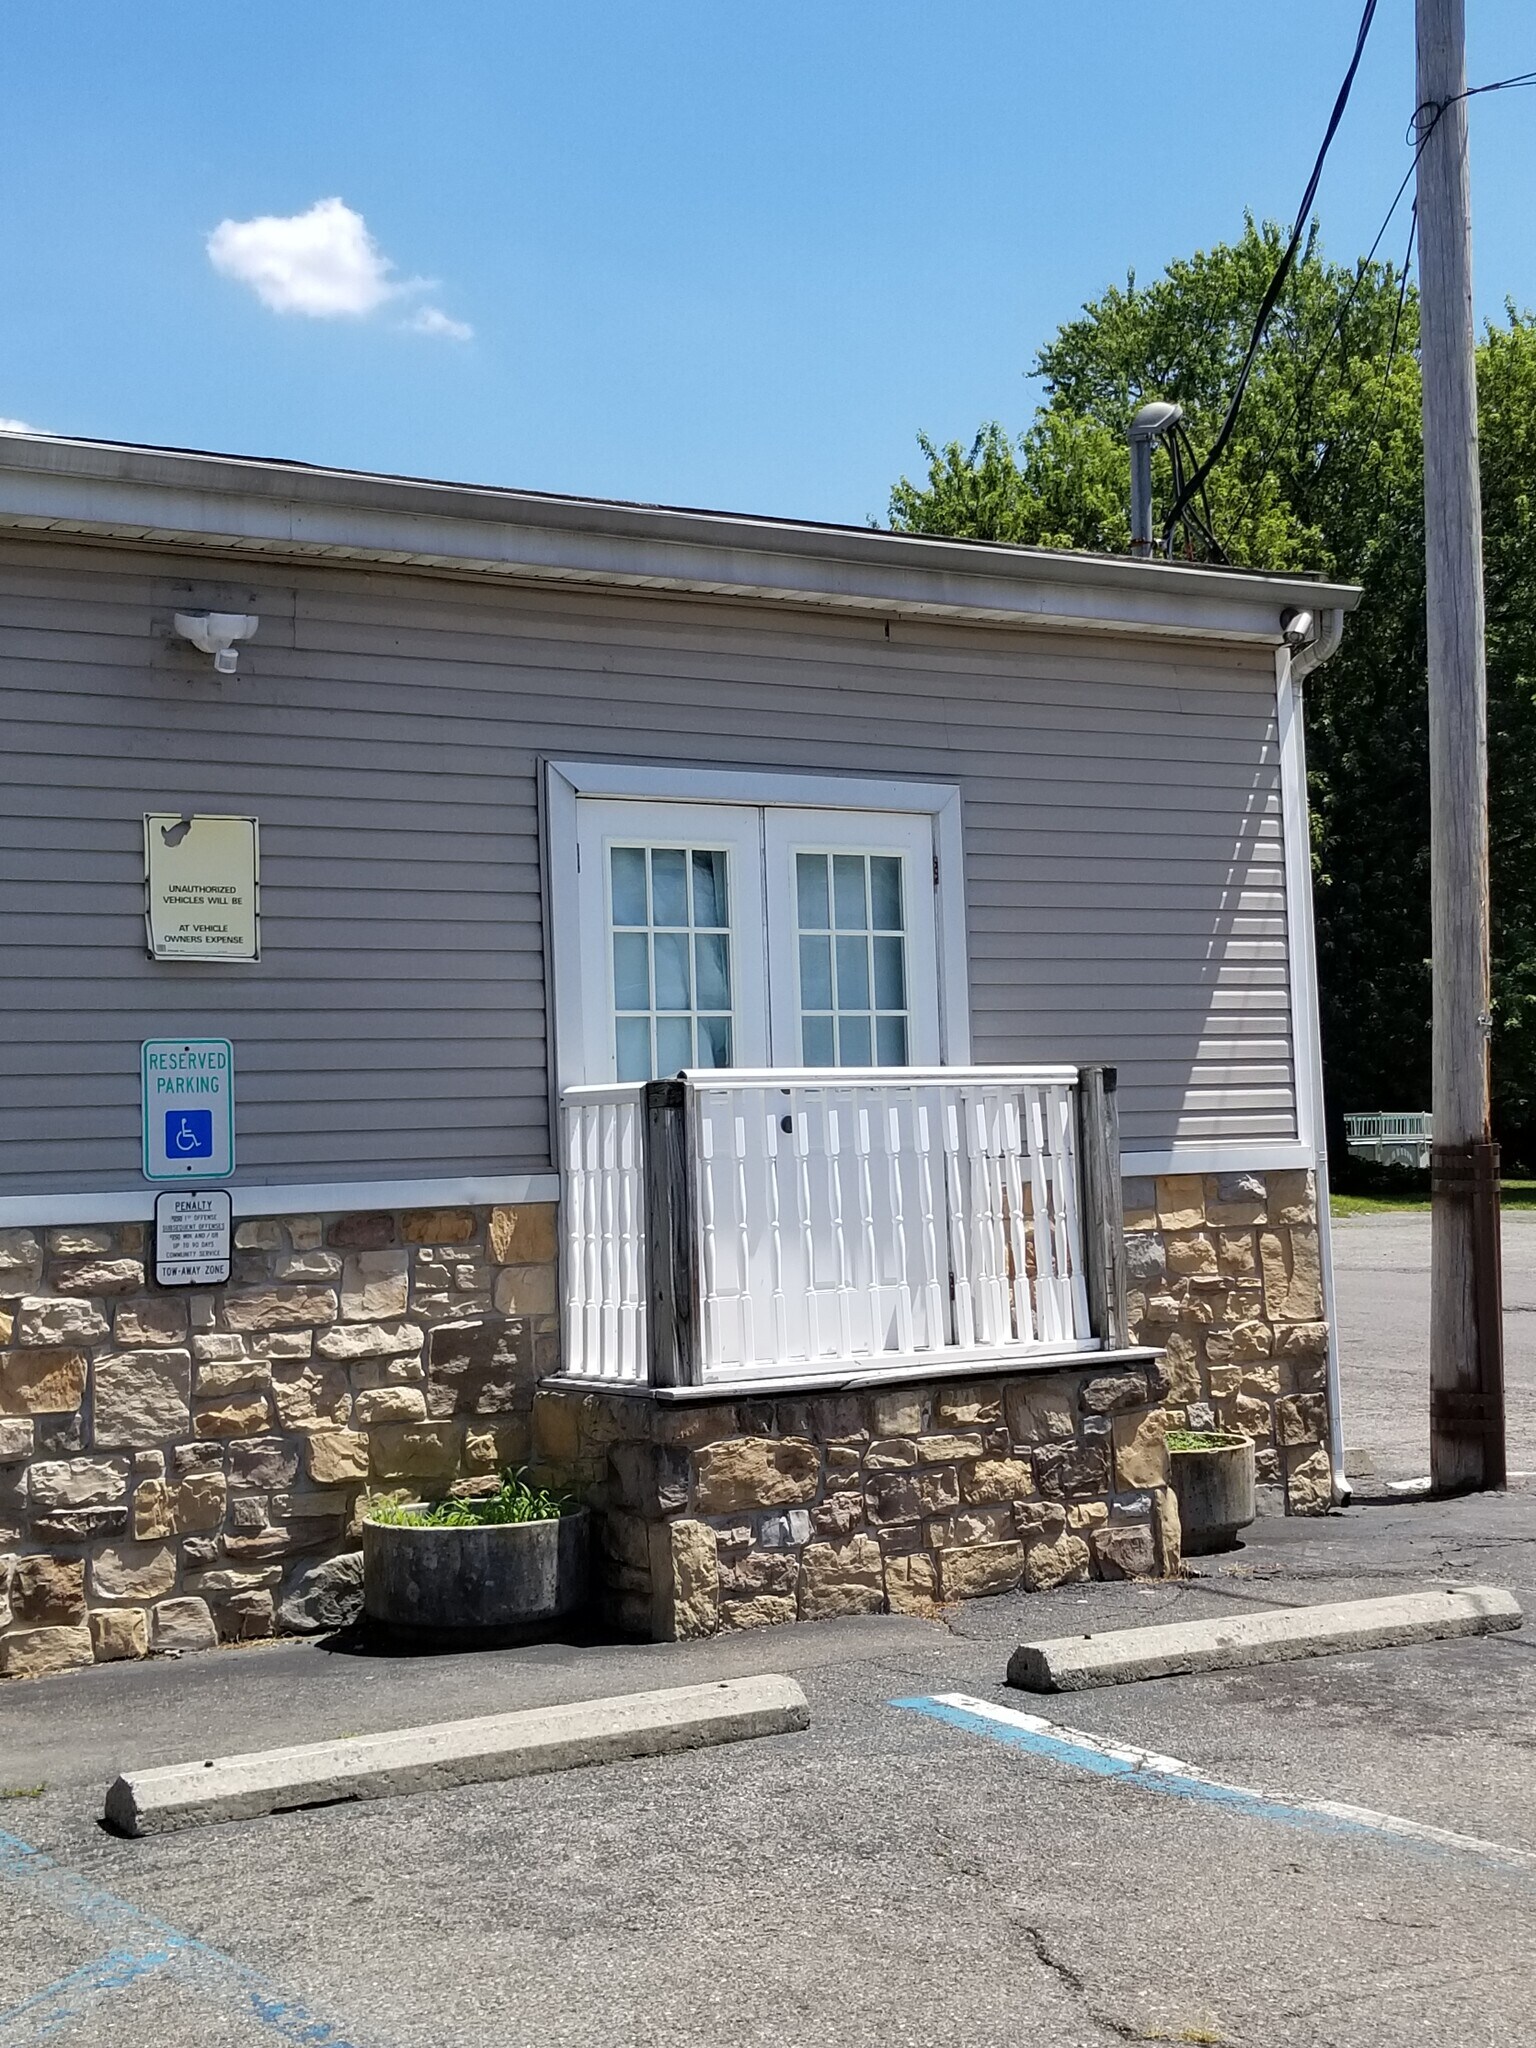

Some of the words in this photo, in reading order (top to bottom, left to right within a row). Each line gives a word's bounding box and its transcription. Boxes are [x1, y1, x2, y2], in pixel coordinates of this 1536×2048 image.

[169, 885, 237, 894] UNAUTHORIZED
[163, 896, 204, 904] VEHICLES
[208, 897, 228, 905] WILL
[232, 897, 242, 905] BE
[179, 924, 190, 932] AT
[164, 935, 203, 943] OWNERS
[206, 936, 244, 944] EXPENSE
[149, 1053, 226, 1070] RESERVED
[157, 1077, 219, 1094] PARKING
[175, 1201, 212, 1211] PENALTY
[163, 1266, 201, 1276] TOW-AWAY
[205, 1265, 224, 1274] ZONE
